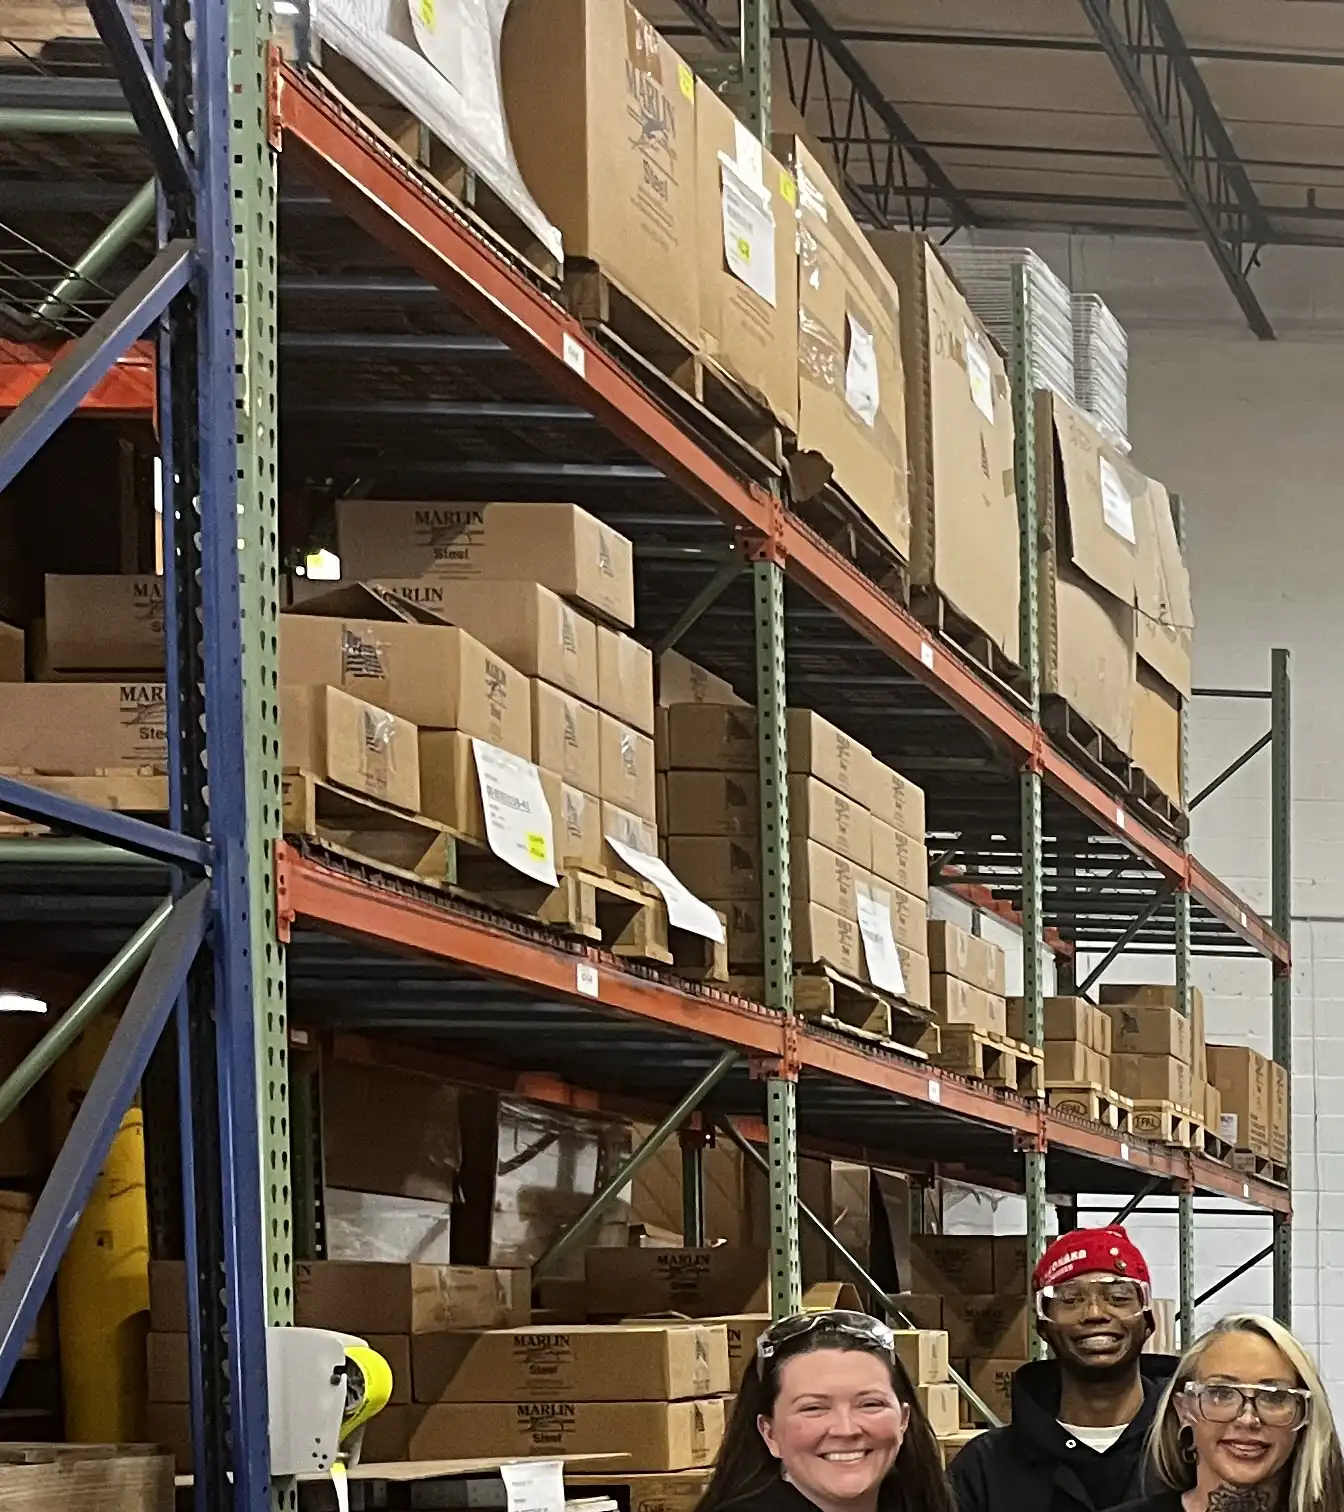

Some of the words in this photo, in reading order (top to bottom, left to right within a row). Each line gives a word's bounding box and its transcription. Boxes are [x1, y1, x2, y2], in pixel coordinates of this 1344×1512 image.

[414, 510, 484, 526] MARLIN
[433, 549, 469, 560] Steel
[514, 1335, 570, 1347] MARLIN
[517, 1404, 576, 1416] MARLIN
